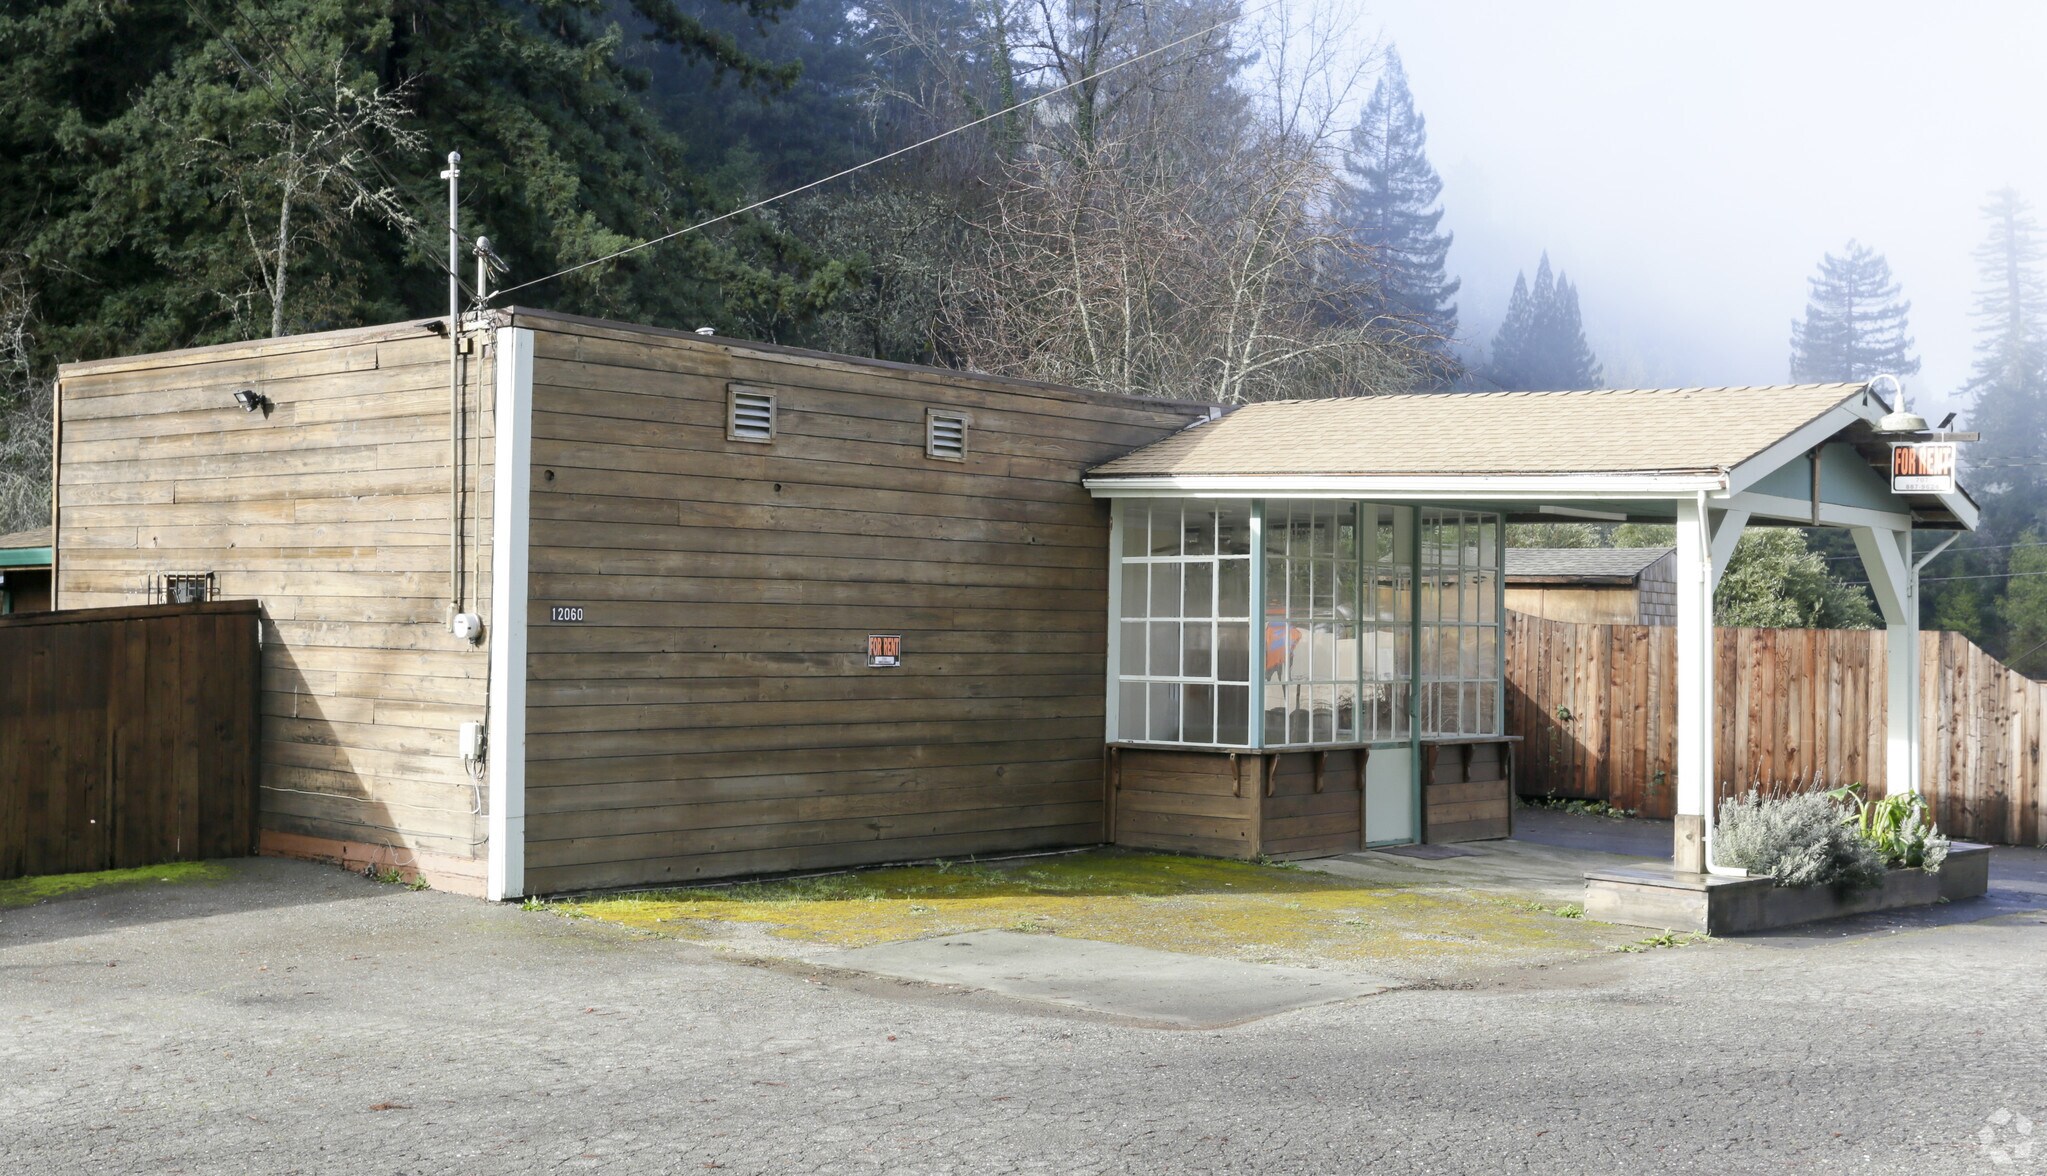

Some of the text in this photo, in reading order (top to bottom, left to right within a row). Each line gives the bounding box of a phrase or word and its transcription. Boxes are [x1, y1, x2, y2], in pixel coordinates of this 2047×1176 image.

[1895, 447, 1952, 475] FOR RENT
[552, 607, 583, 621] 12060
[869, 637, 899, 656] FOR RENT
